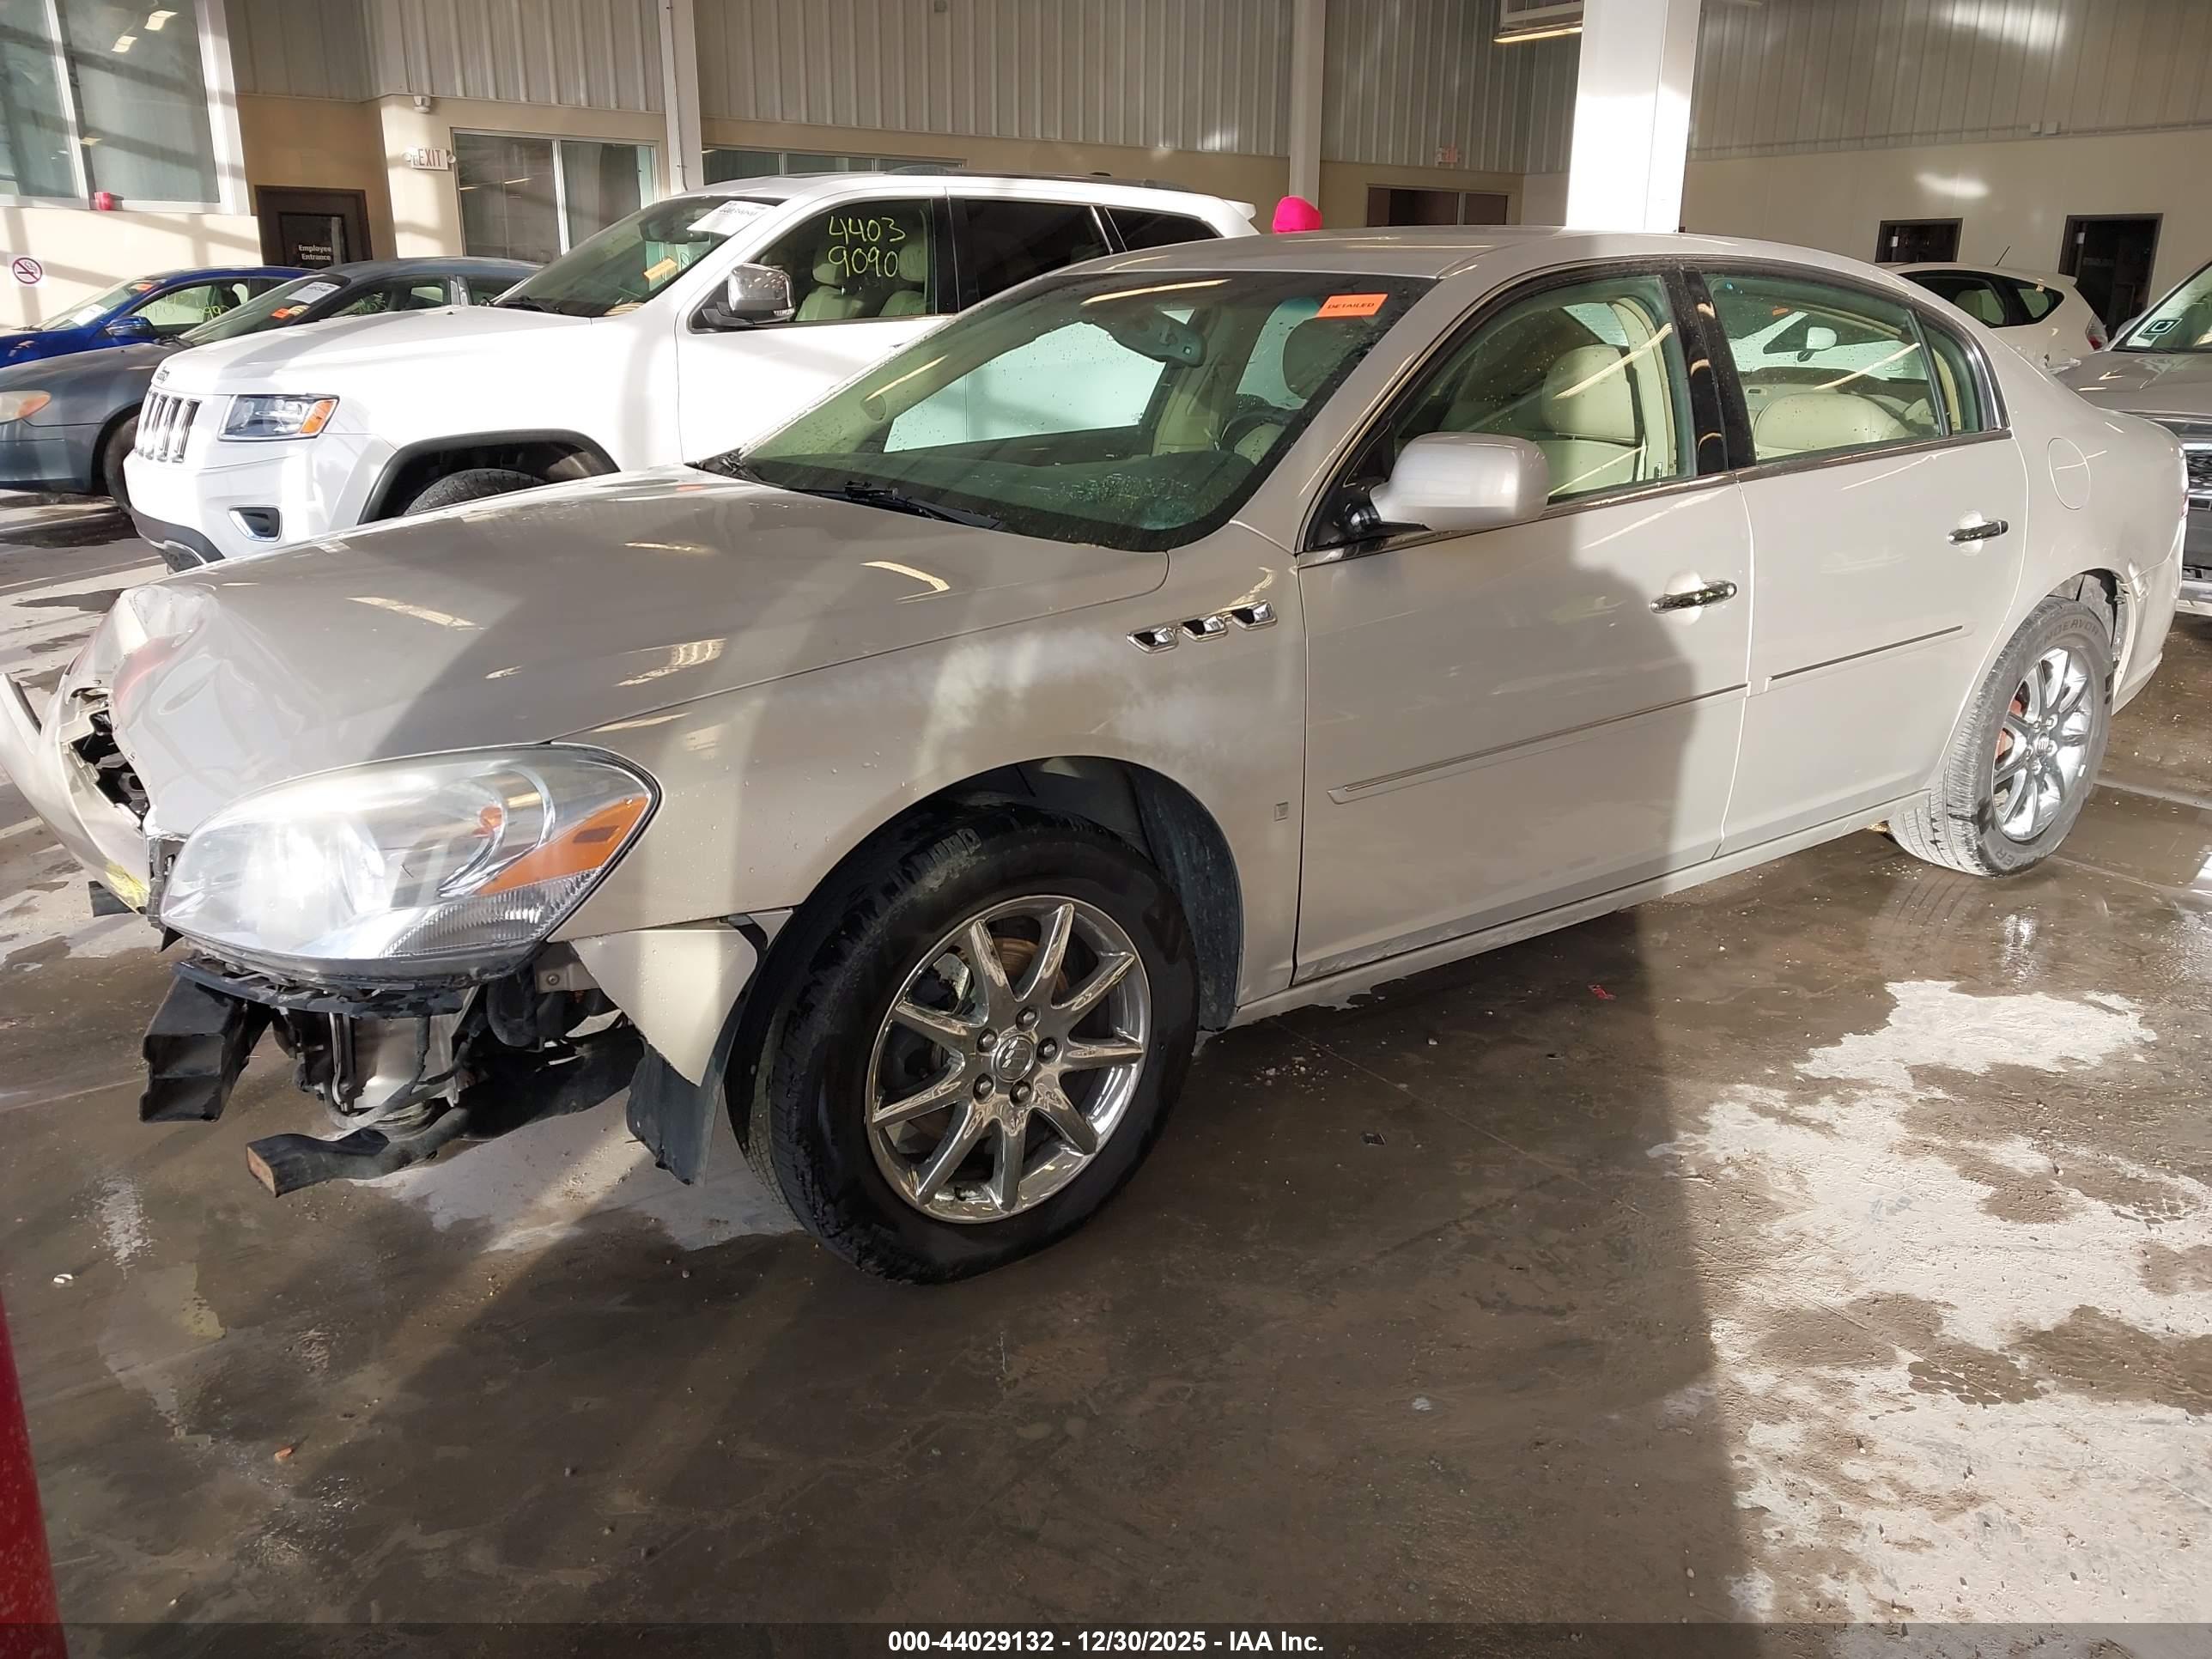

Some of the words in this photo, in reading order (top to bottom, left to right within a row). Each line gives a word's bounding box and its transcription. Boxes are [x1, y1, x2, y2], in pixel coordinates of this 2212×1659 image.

[417, 149, 441, 167] EXIT
[829, 216, 906, 245] 4403
[298, 245, 332, 253] Employee
[828, 246, 898, 277] 9090
